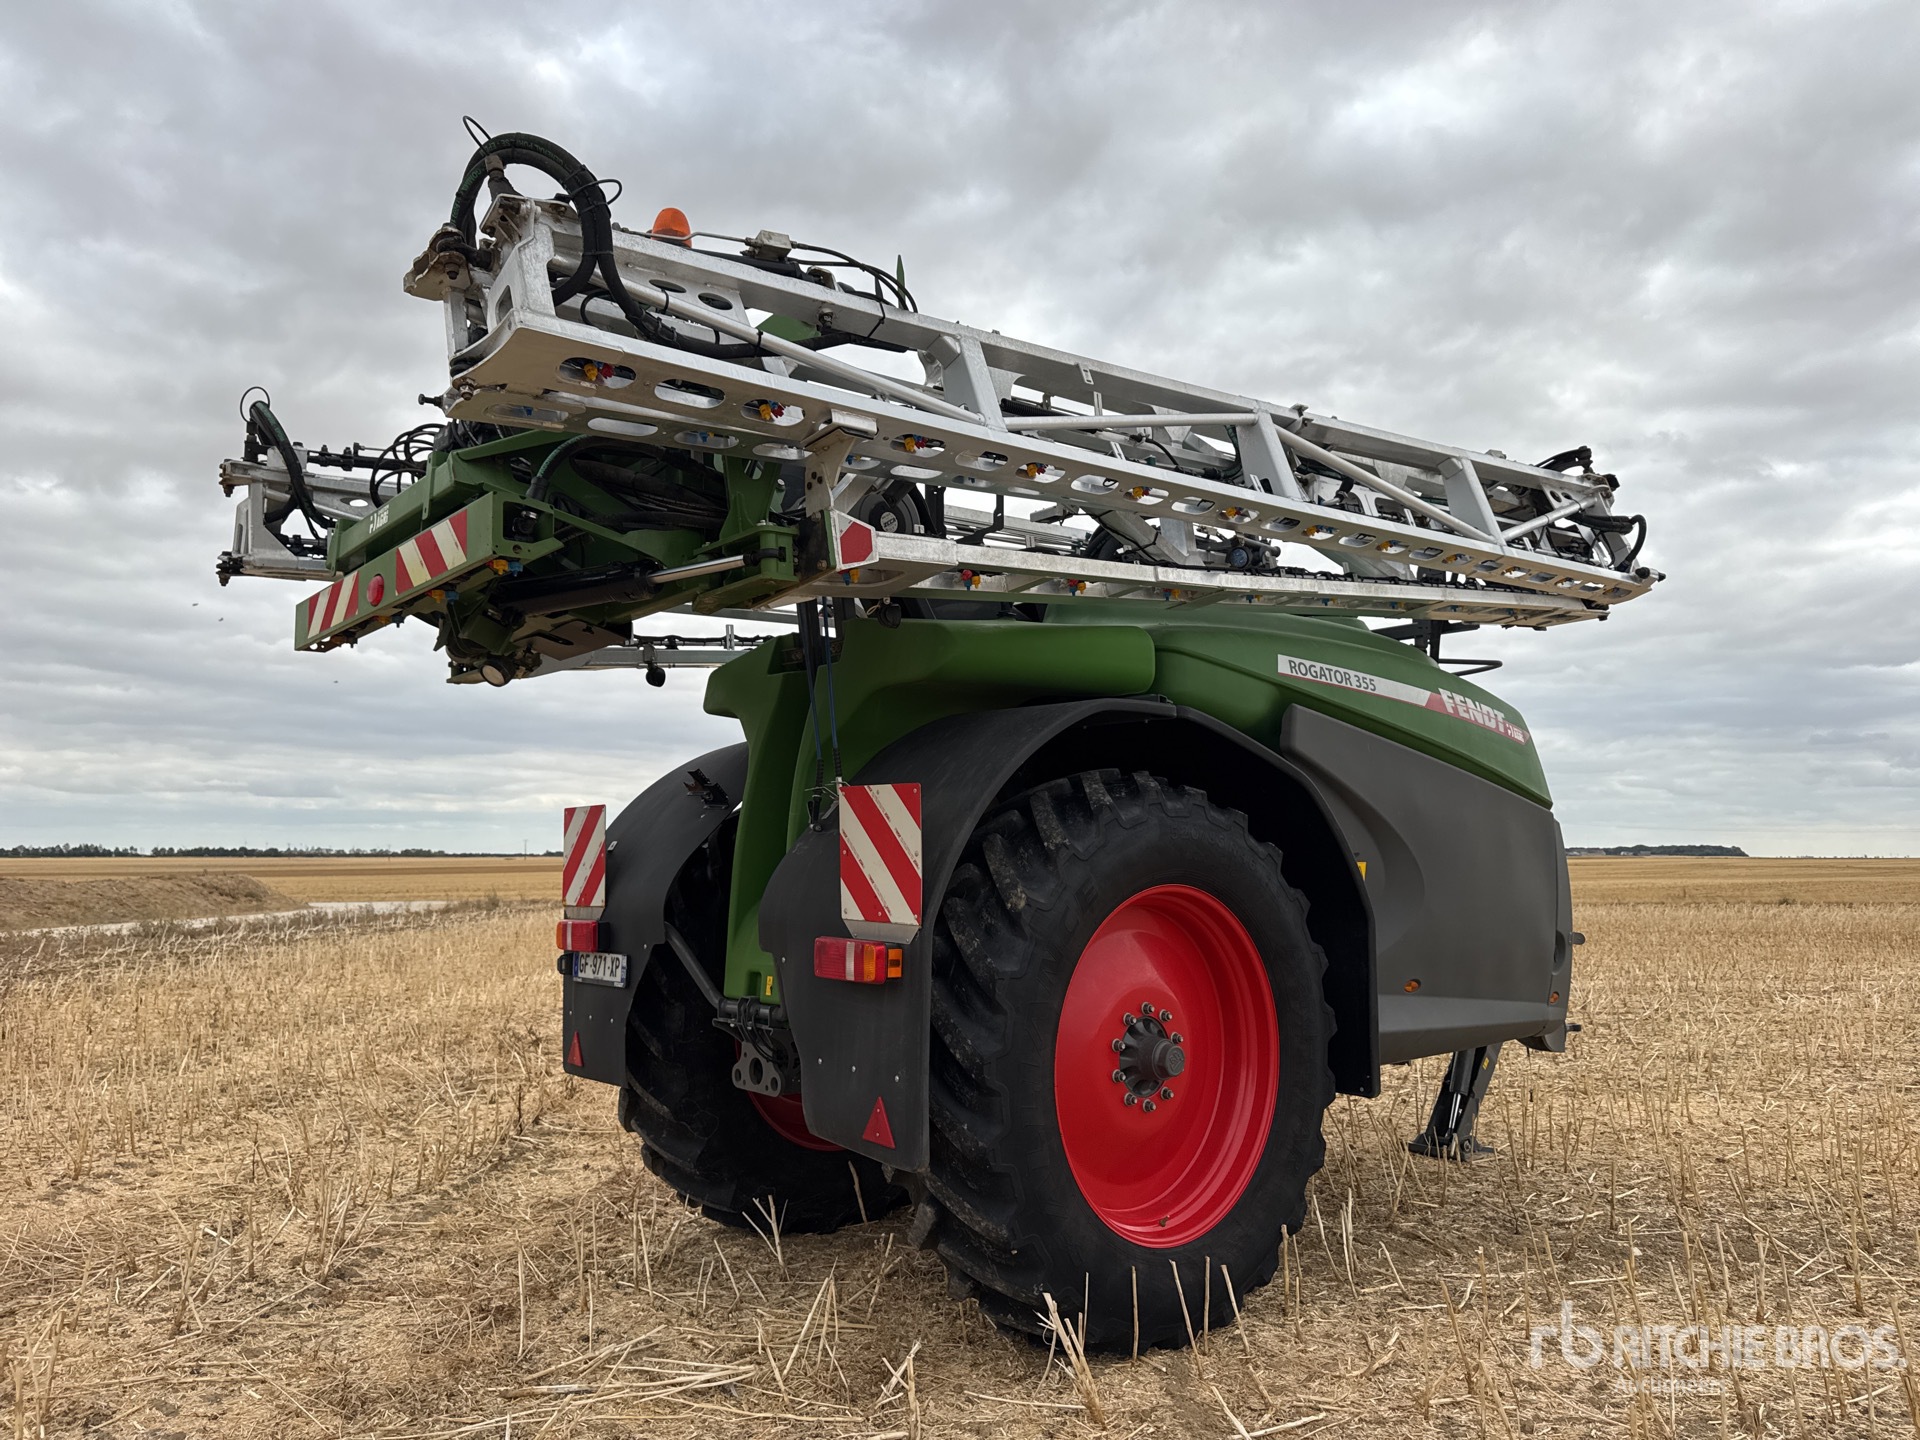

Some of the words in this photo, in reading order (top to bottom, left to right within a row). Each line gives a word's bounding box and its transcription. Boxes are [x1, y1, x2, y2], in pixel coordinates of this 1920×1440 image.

[1287, 659, 1353, 687] ROGATOR
[1354, 675, 1377, 692] 355
[1438, 687, 1505, 733] FENDT
[579, 953, 620, 978] GF-971-XP
